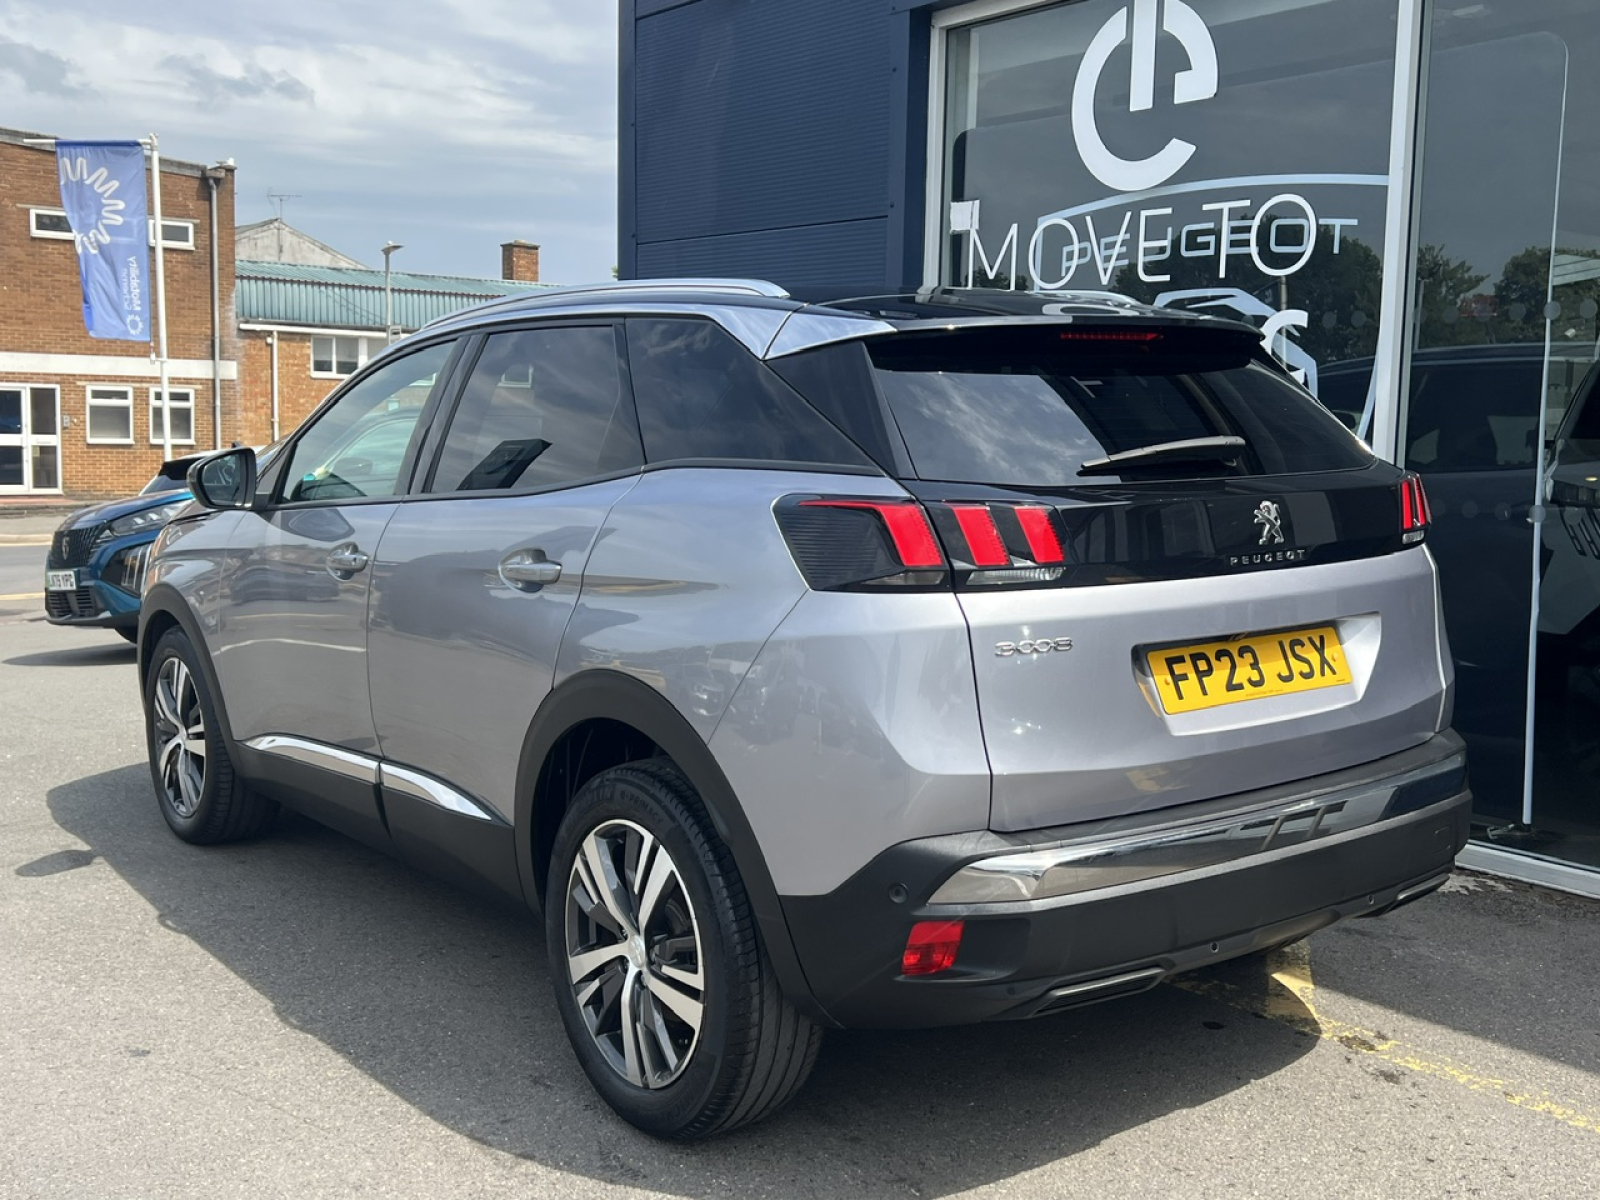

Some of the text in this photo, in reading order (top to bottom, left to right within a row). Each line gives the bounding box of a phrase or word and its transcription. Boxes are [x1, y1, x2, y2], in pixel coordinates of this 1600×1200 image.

[968, 193, 1317, 291] MOVE TO
[1061, 217, 1358, 277] PEUGEOT
[1230, 549, 1306, 566] PEUGEOT
[994, 636, 1074, 656] 3008
[1165, 634, 1337, 700] FP23 JSX
